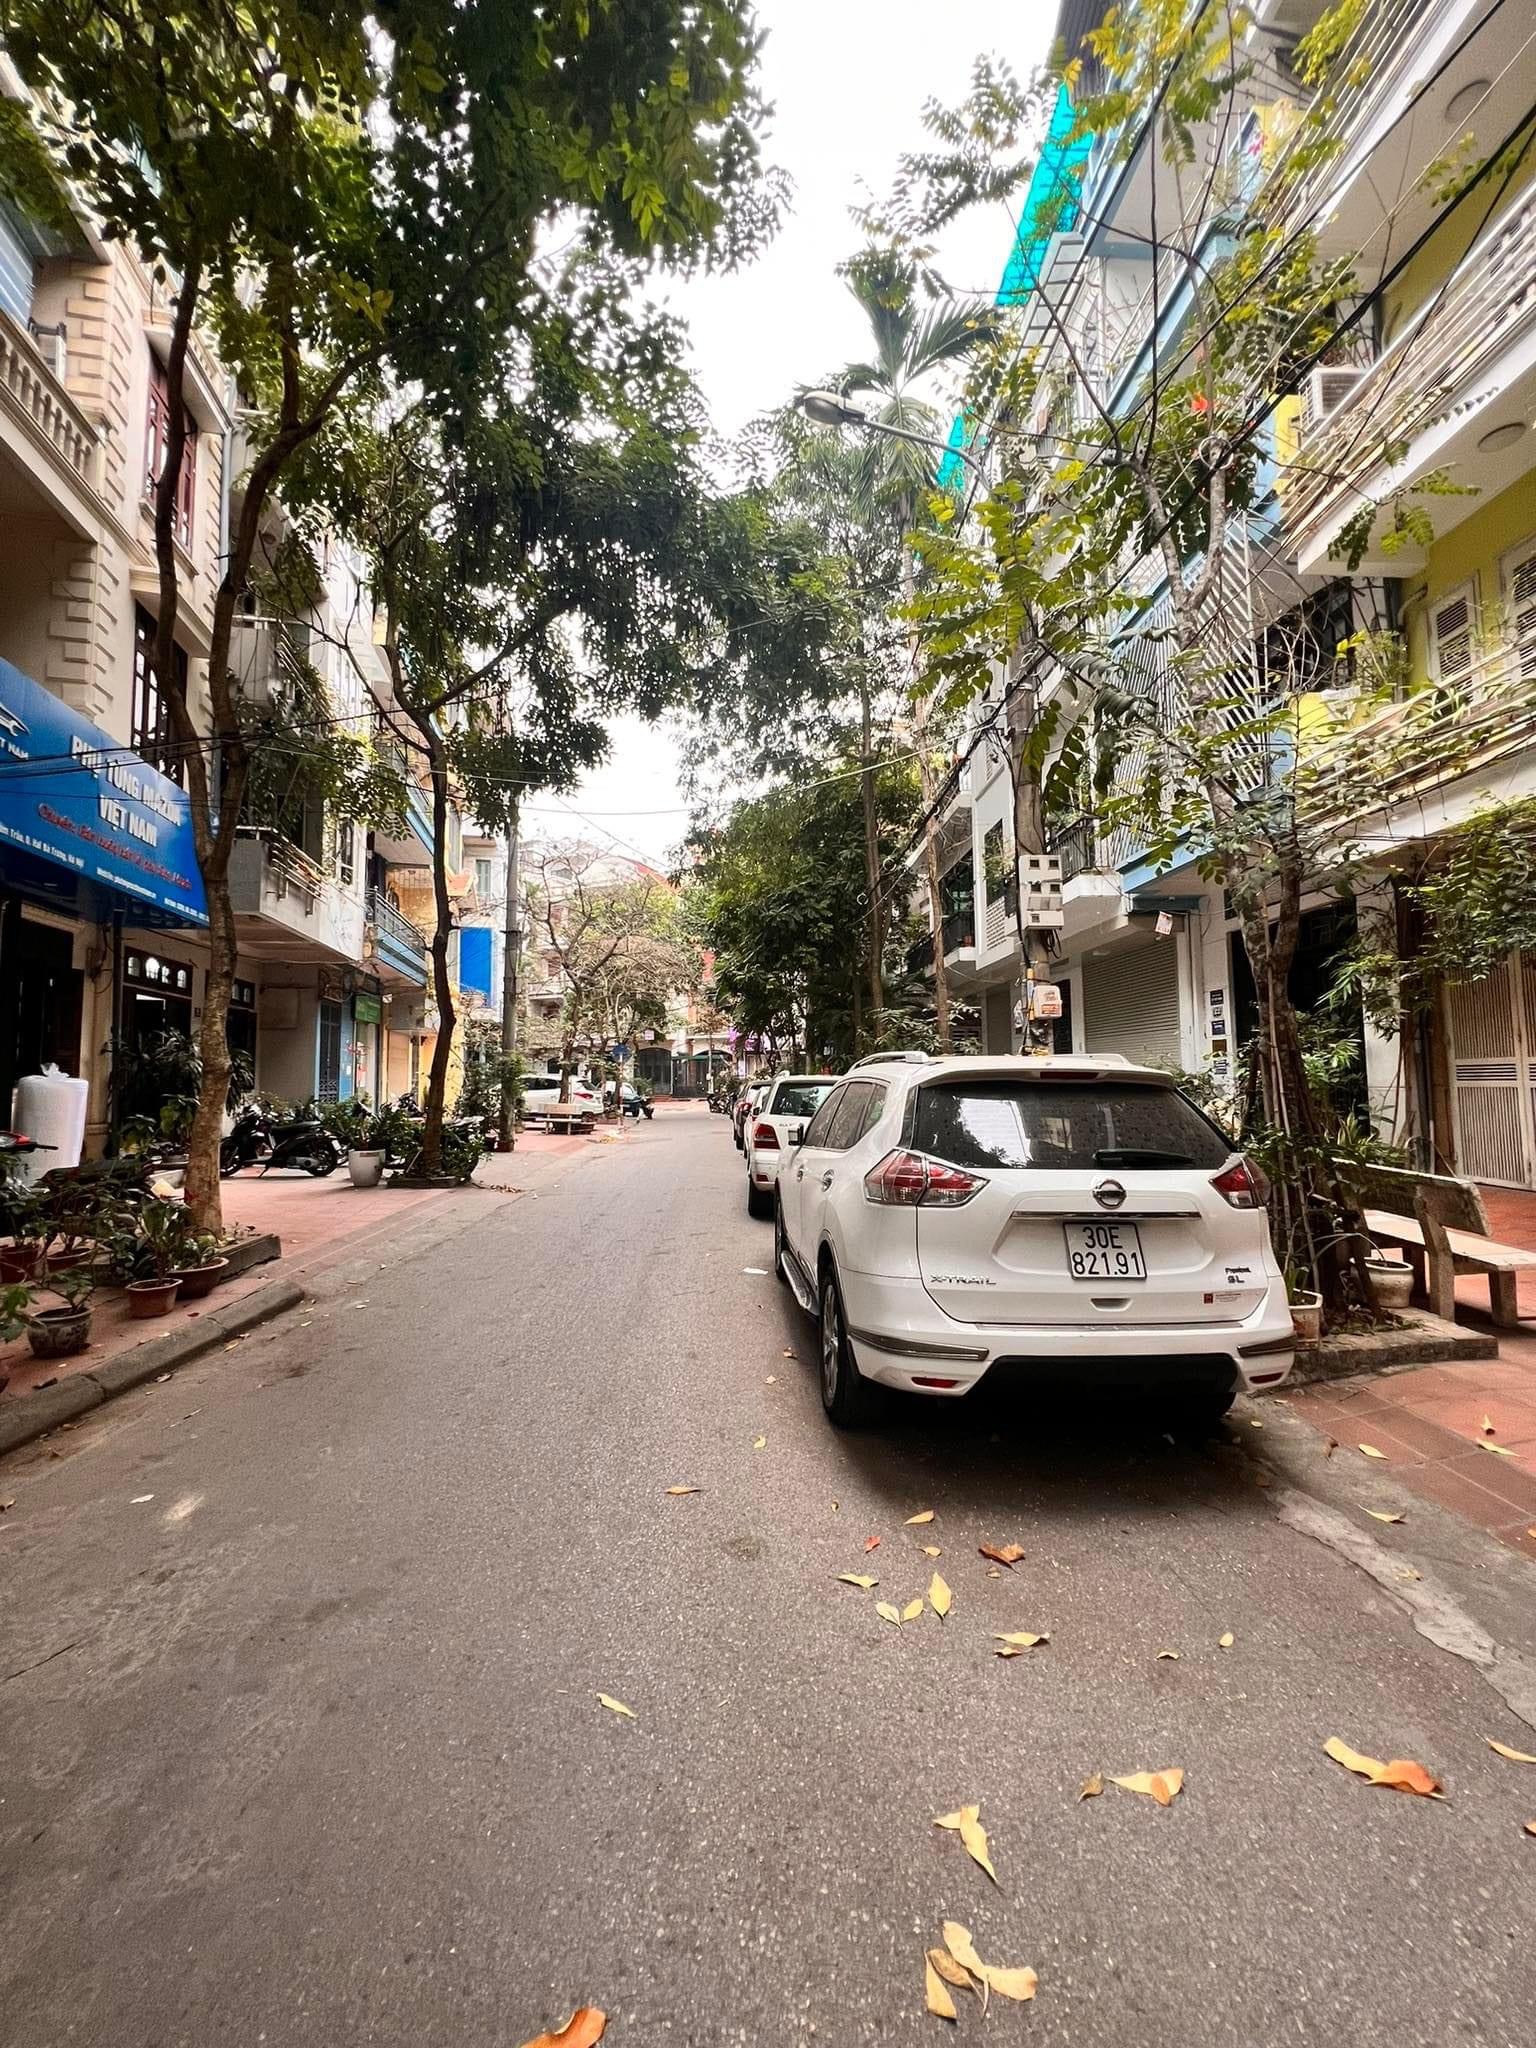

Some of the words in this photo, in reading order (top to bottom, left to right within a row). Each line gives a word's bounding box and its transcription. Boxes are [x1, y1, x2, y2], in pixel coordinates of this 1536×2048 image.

[99, 794, 127, 831] VIỆT
[129, 811, 158, 847] NAM
[1082, 1226, 1123, 1249] 30E
[1072, 1251, 1141, 1275] 821.91
